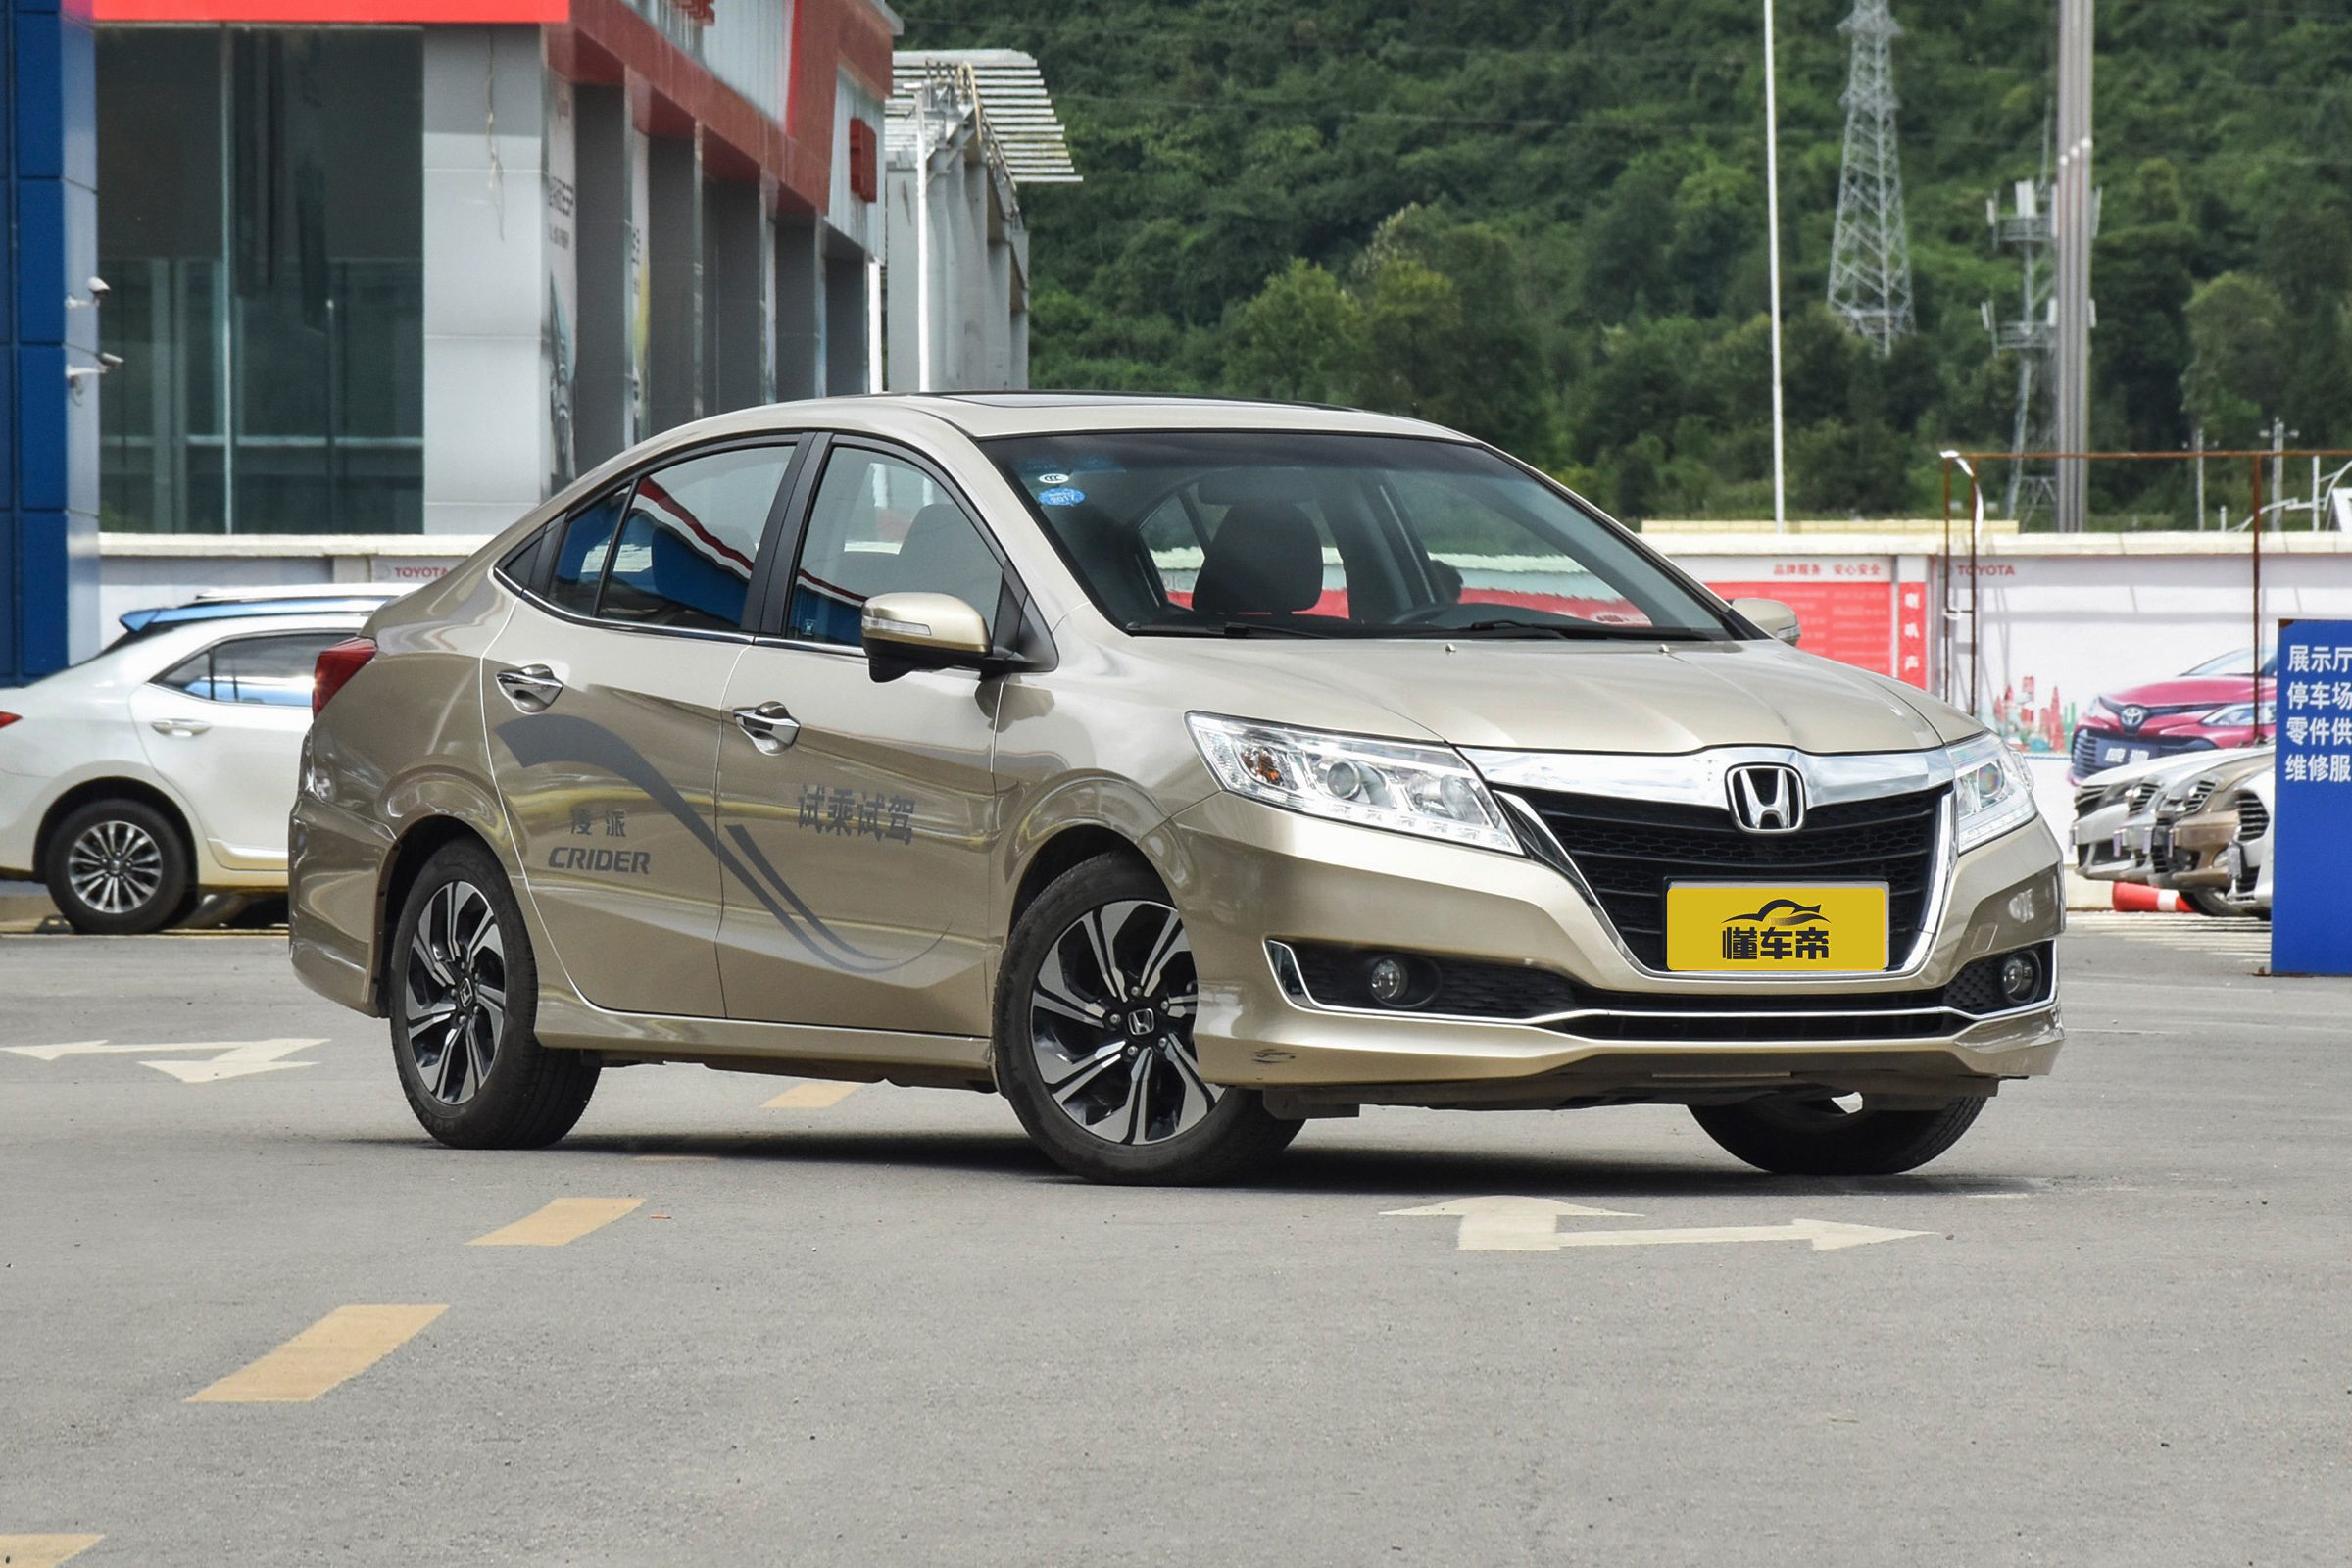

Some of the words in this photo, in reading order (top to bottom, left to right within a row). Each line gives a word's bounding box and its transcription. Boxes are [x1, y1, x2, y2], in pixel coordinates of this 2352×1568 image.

[394, 566, 449, 578] TOYOTA
[1956, 564, 2015, 576] TOYOTA
[2287, 644, 2352, 673] 展示厅
[2286, 680, 2352, 710] 停车场
[2285, 716, 2352, 746] 零件供
[2284, 753, 2352, 782] 维修服
[798, 784, 916, 845] 试乘试驾
[548, 846, 651, 874] CRIDER
